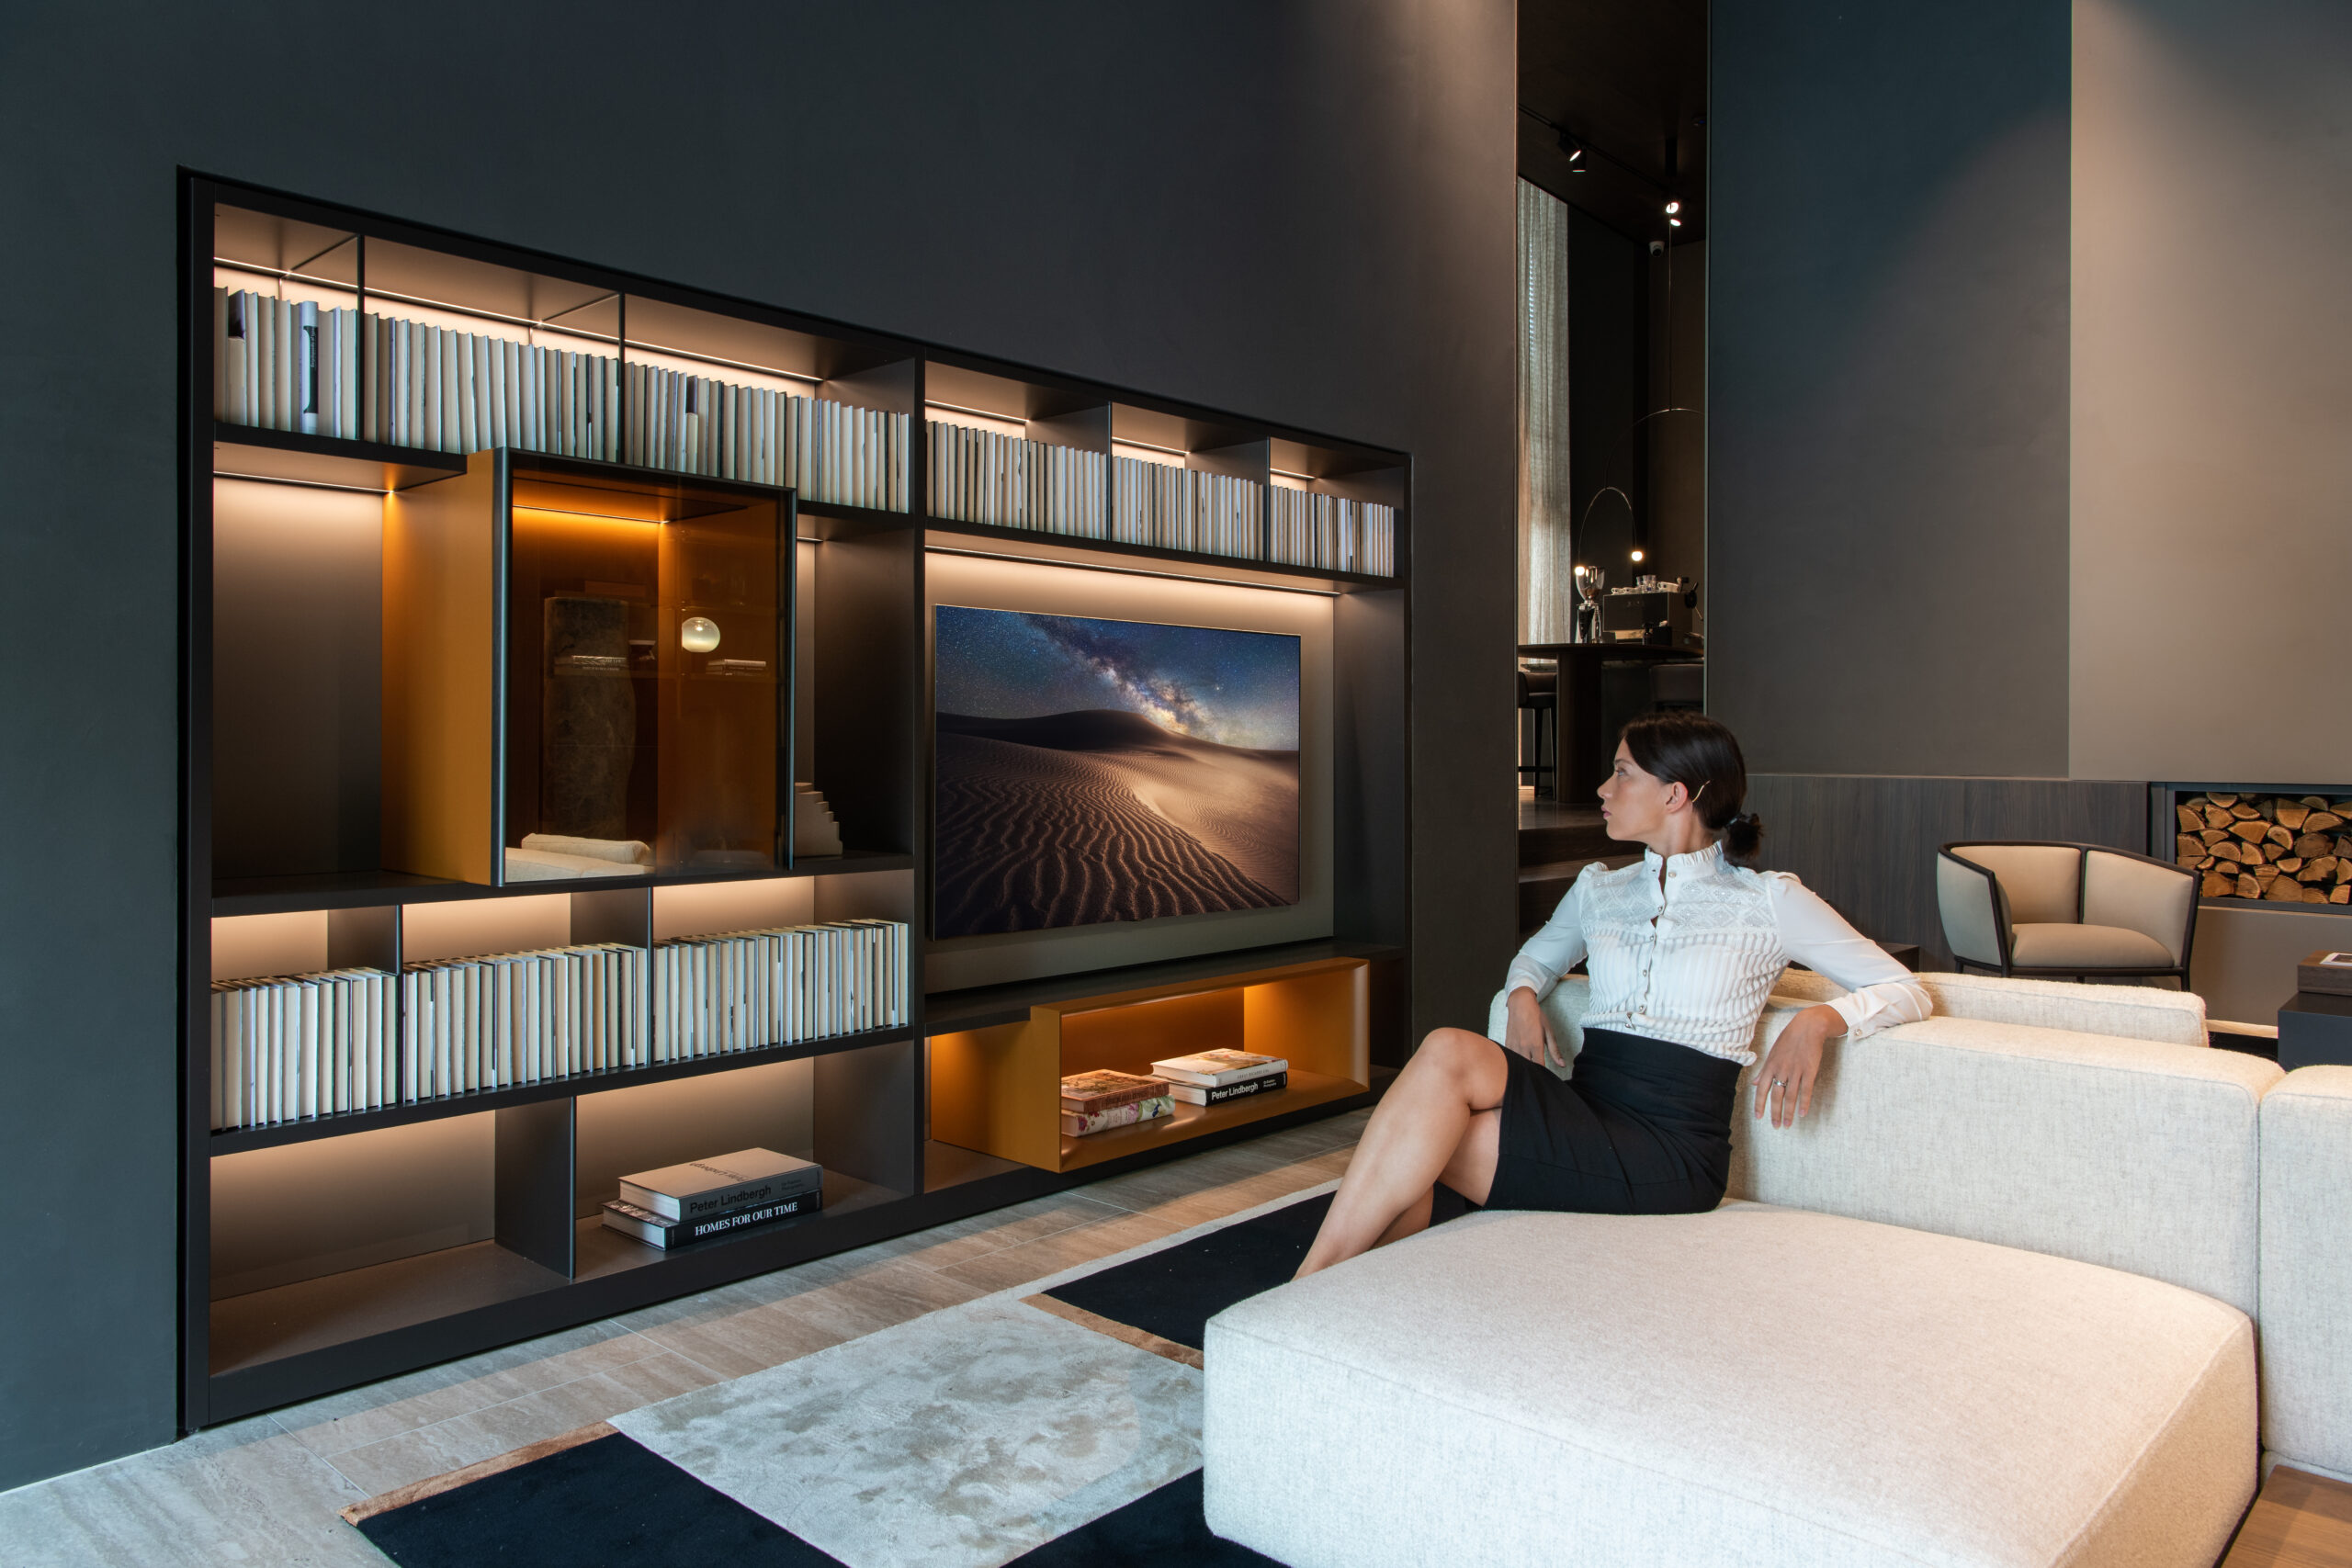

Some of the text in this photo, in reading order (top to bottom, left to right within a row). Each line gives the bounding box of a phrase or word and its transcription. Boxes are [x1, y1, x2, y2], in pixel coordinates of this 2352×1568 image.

[1211, 1082, 1258, 1100] Peter Lindbergh
[690, 1199, 718, 1213] Peter
[721, 1185, 771, 1206] Lindbergh
[694, 1202, 798, 1236] HOMES FOR OUR TIME
